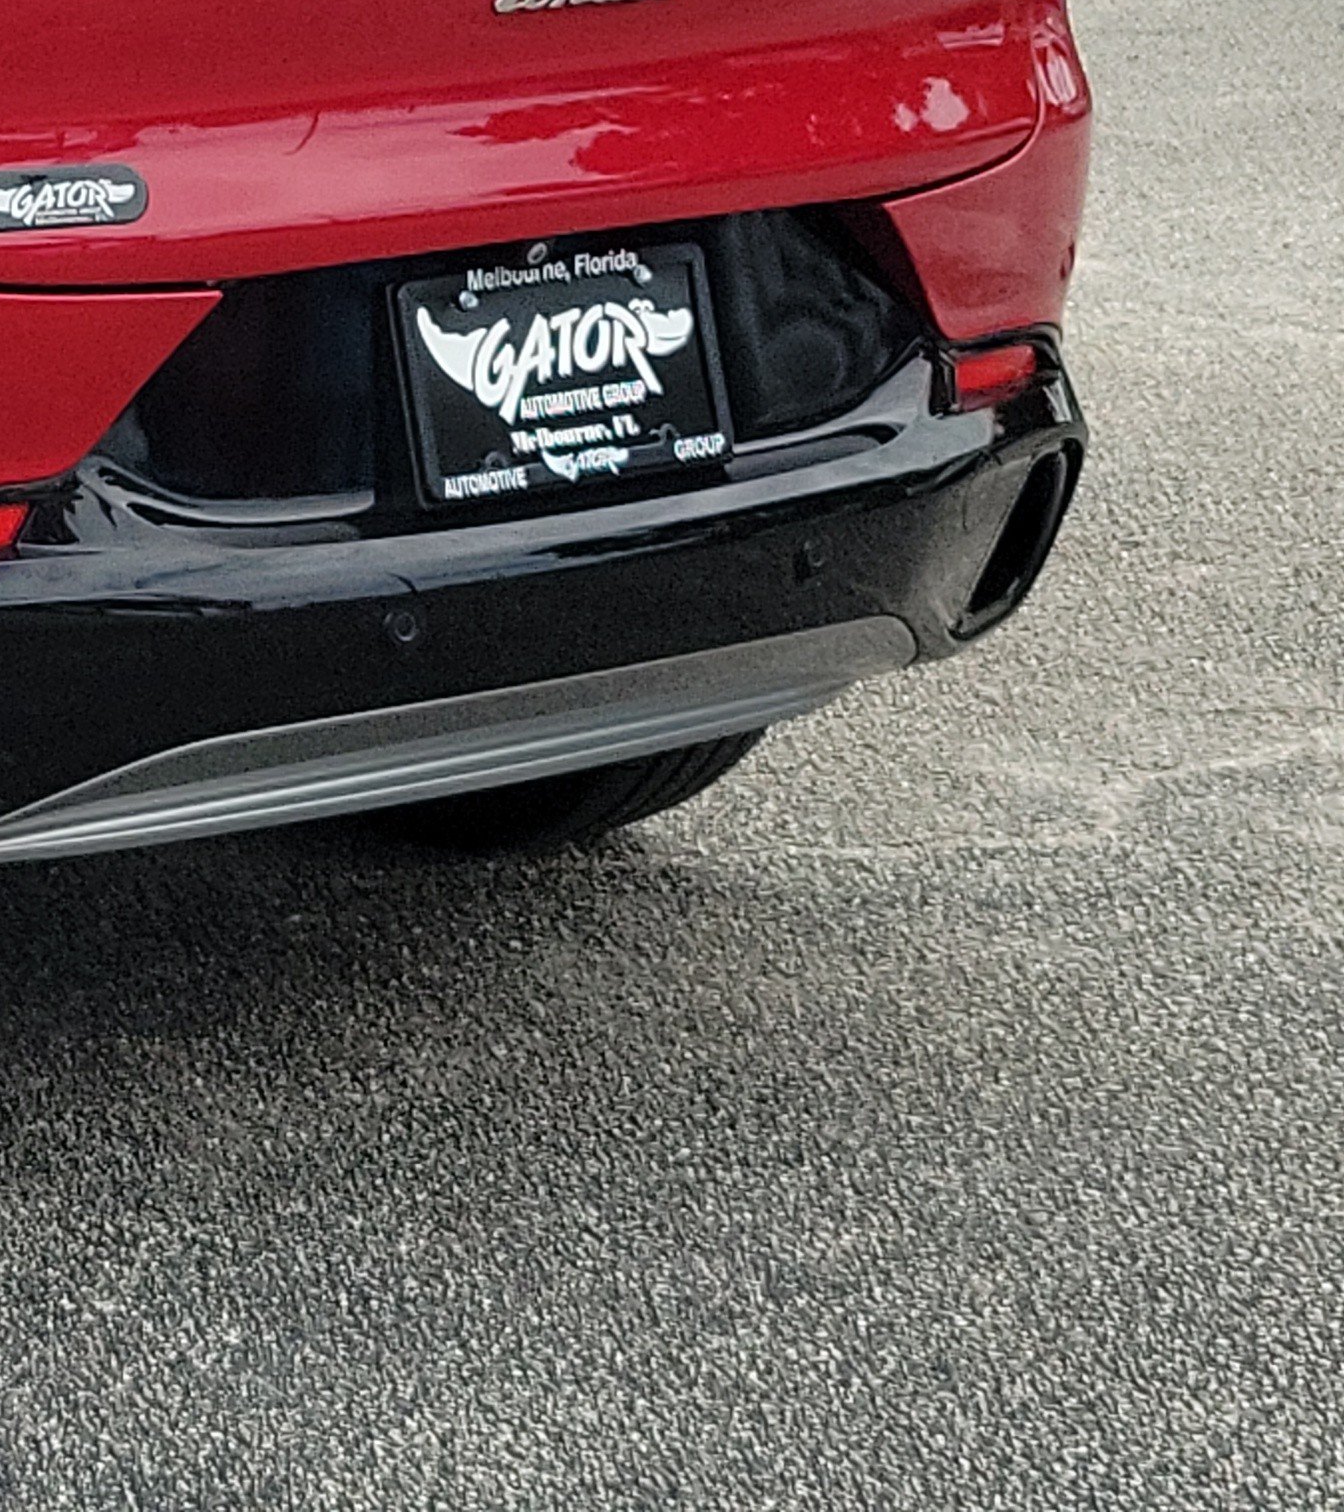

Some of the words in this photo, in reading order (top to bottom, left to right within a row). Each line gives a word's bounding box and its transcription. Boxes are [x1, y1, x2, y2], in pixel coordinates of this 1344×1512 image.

[11, 180, 115, 227] GATOR
[574, 248, 639, 279] Florida
[473, 301, 664, 426] GATOR
[519, 386, 604, 421] AUTOMOTIVE
[602, 379, 647, 408] GROUP
[444, 467, 529, 500] AUTOMOTIVE
[673, 433, 725, 463] GROUP
